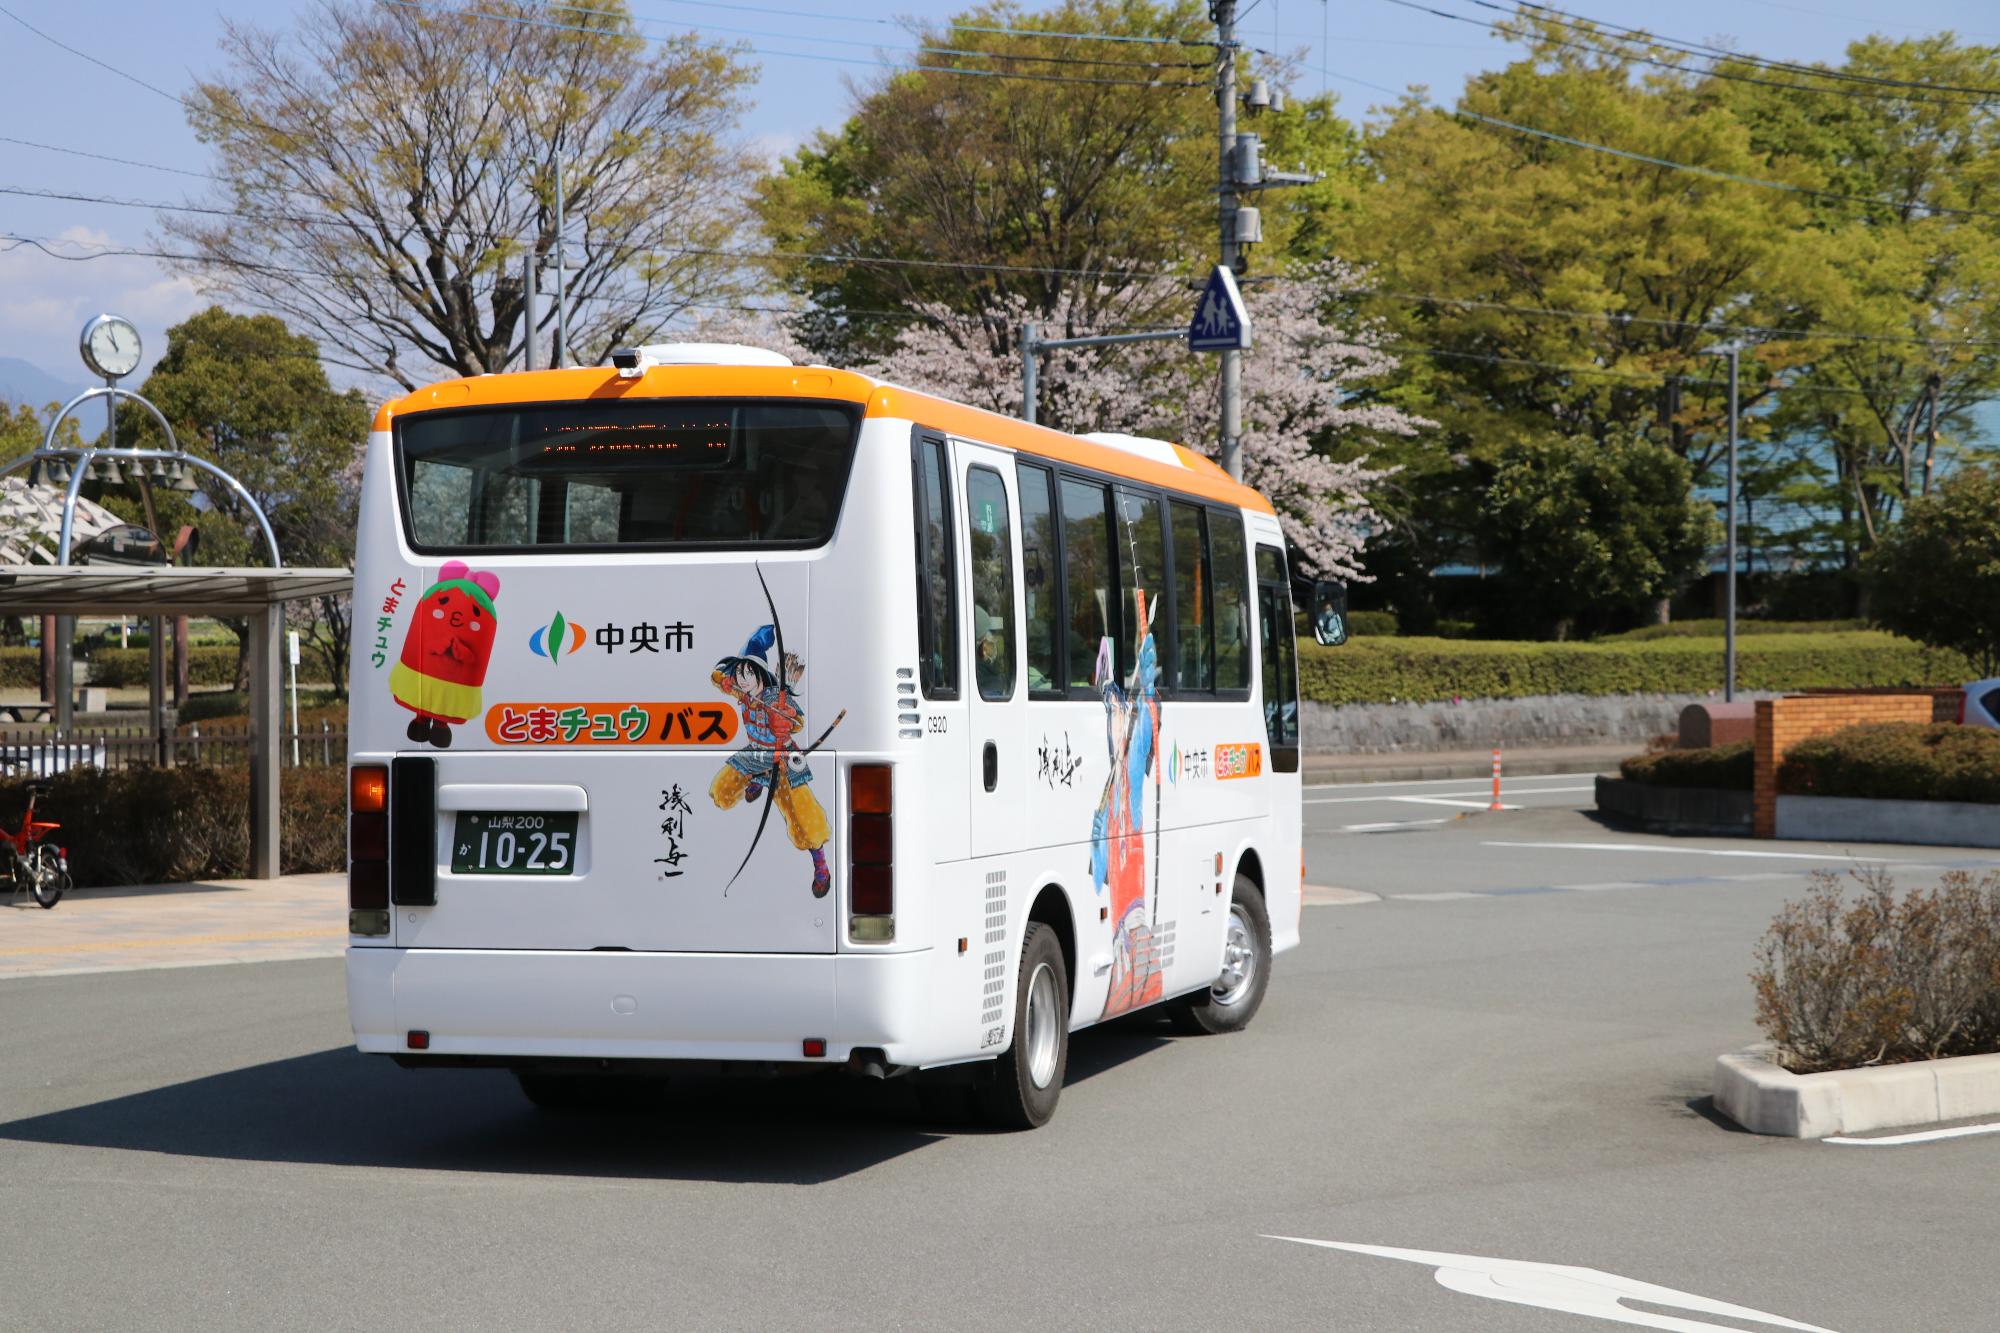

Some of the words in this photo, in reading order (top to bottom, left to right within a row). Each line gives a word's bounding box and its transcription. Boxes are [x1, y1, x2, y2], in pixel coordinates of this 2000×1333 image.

[371, 577, 406, 669] とまチュウ
[595, 621, 694, 654] 中央市
[928, 715, 948, 733] C920
[1184, 748, 1207, 780] 中央市
[459, 843, 471, 856] か
[479, 832, 570, 869] 10-25
